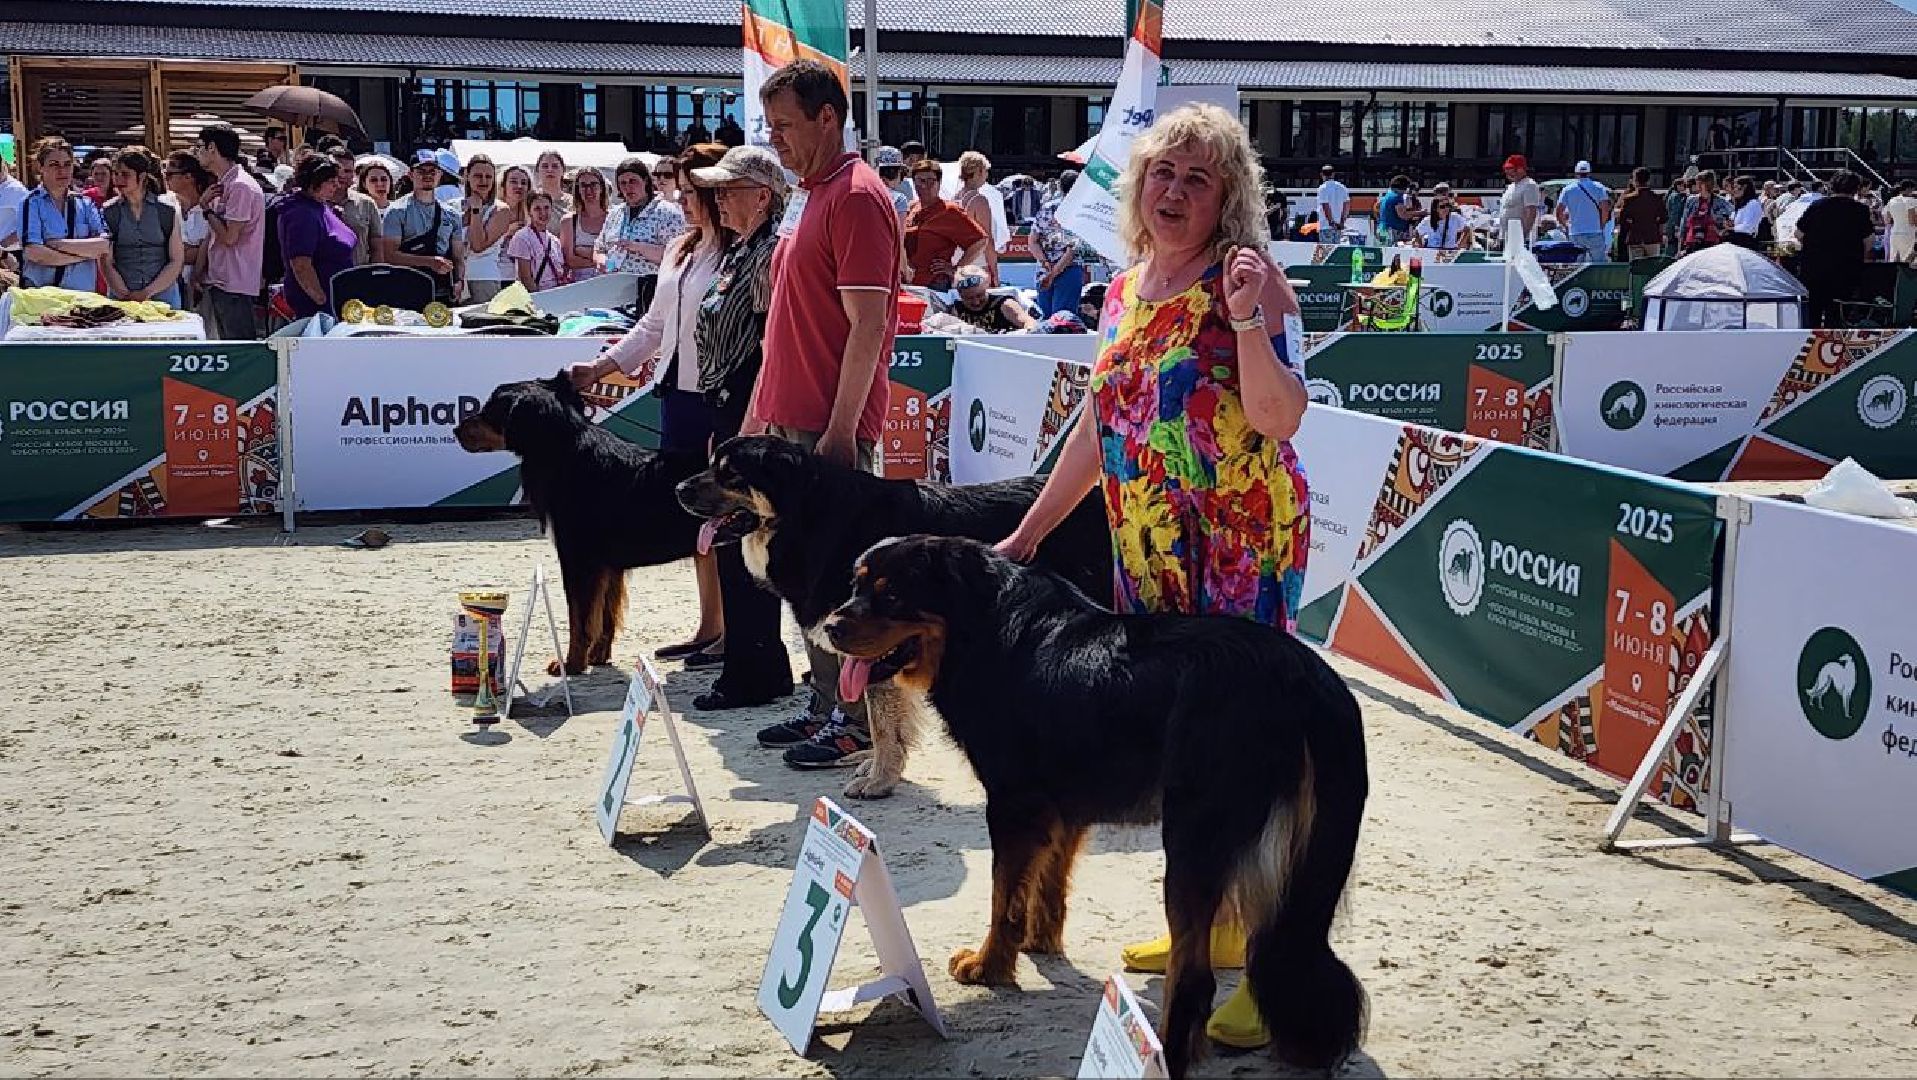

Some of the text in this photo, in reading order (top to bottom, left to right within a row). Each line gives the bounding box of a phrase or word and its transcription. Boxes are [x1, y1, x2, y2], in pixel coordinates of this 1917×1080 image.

[1298, 293, 1340, 303] ОССИЯ
[1475, 343, 1524, 360] 2025
[168, 354, 230, 372] 2025
[1349, 383, 1441, 402] РОССИЯ
[1655, 383, 1723, 394] Российская
[9, 400, 129, 421] РОССИЯ
[1654, 401, 1748, 409] кинологическая
[341, 396, 480, 432] AlphaP
[1472, 409, 1518, 420] ИЮНЯ
[1654, 414, 1718, 428] федерация
[885, 419, 920, 431] ЮНЯ
[174, 428, 230, 441] ИЮНЯ
[340, 436, 456, 446] ПРОФЕССИОНАЛЬНЫ
[1617, 503, 1673, 543] 2025
[1490, 539, 1581, 597] РОССИЯ
[1613, 630, 1664, 665] ИЮНЯ
[779, 880, 829, 1008] 3
